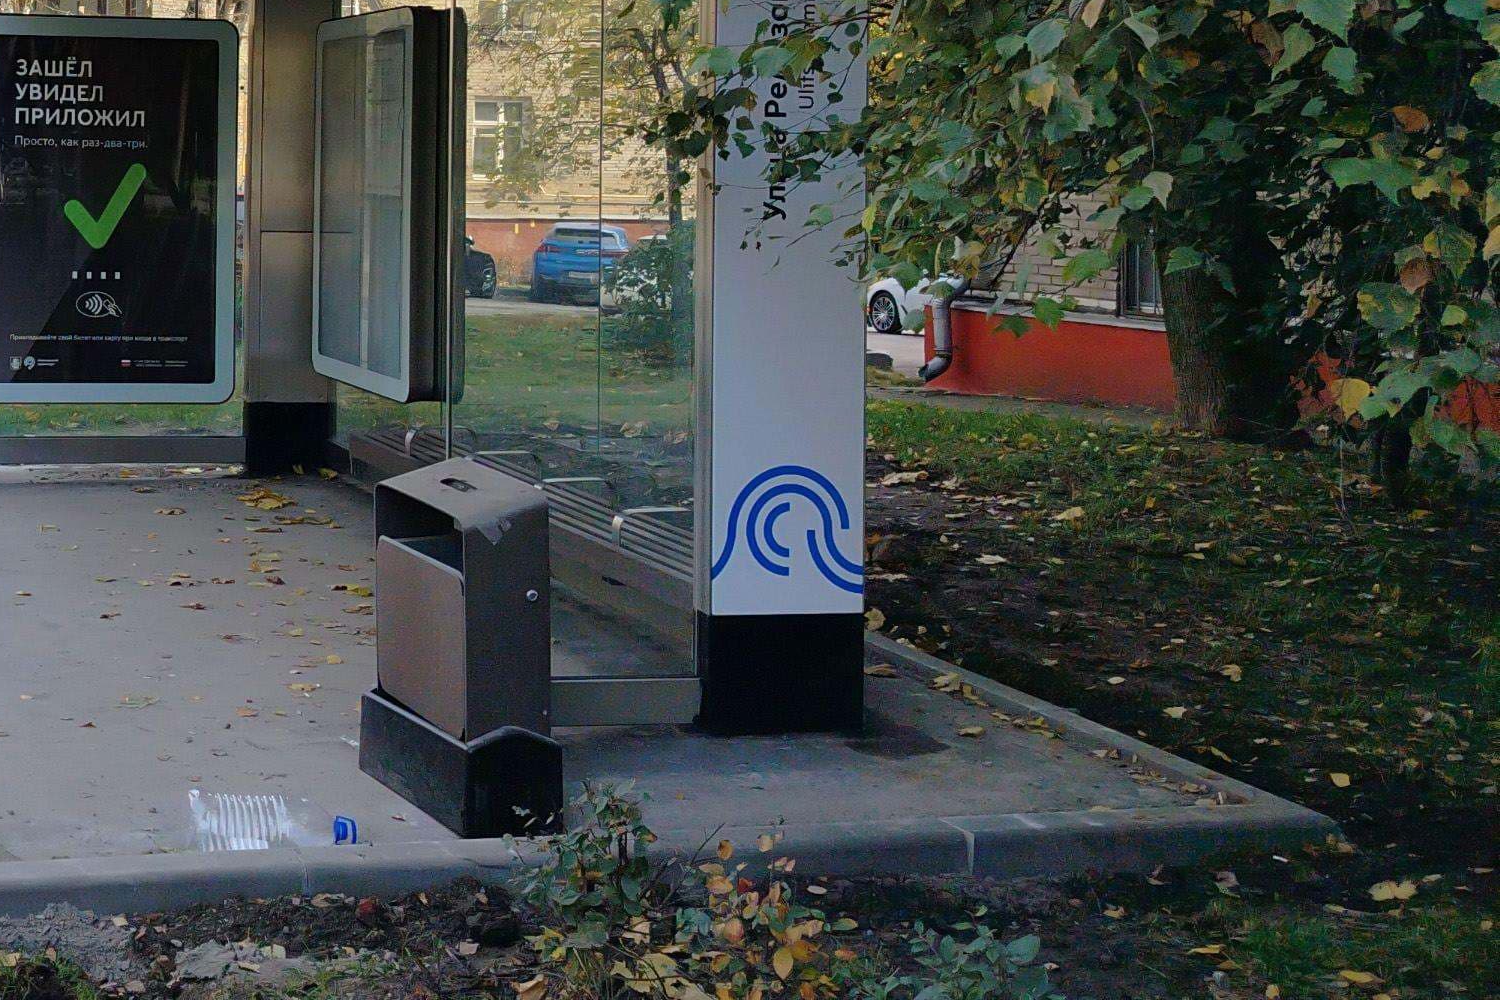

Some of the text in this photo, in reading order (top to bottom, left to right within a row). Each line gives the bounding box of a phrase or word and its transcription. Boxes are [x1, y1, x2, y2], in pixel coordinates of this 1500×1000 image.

[15, 56, 93, 78] ЗАШЁЛ
[14, 82, 104, 105] УВИДЕЛ
[798, 62, 815, 109] Ulits
[14, 107, 146, 128] ПРИЛОЖИЛ
[14, 135, 148, 149] Просто, как раз-два-три.
